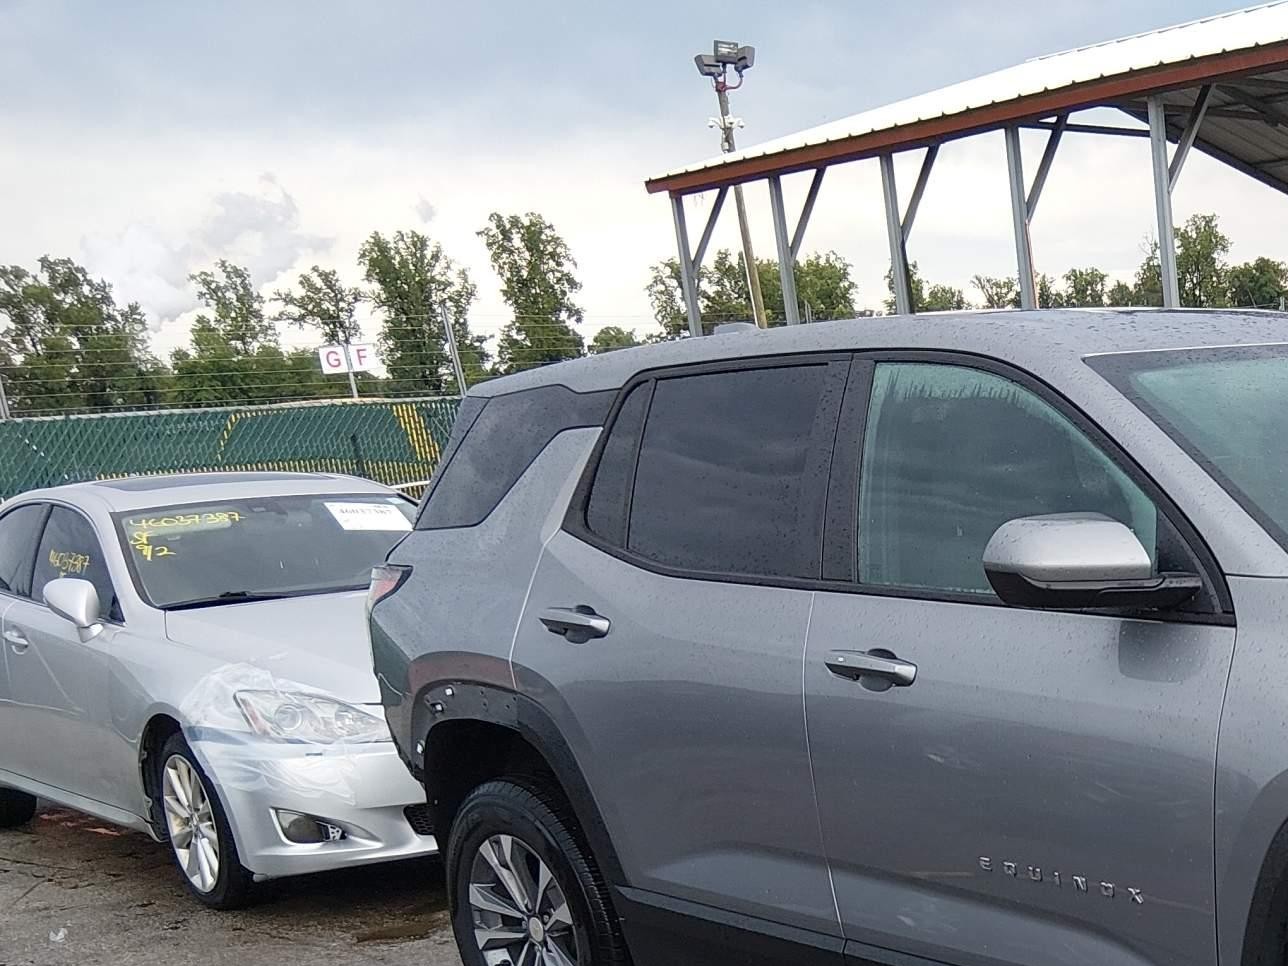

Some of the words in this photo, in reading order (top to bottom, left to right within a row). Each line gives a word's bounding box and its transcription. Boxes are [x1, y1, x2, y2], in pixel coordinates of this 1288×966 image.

[326, 350, 342, 369] G
[356, 348, 368, 367] F
[979, 855, 1145, 905] EQUINOX
